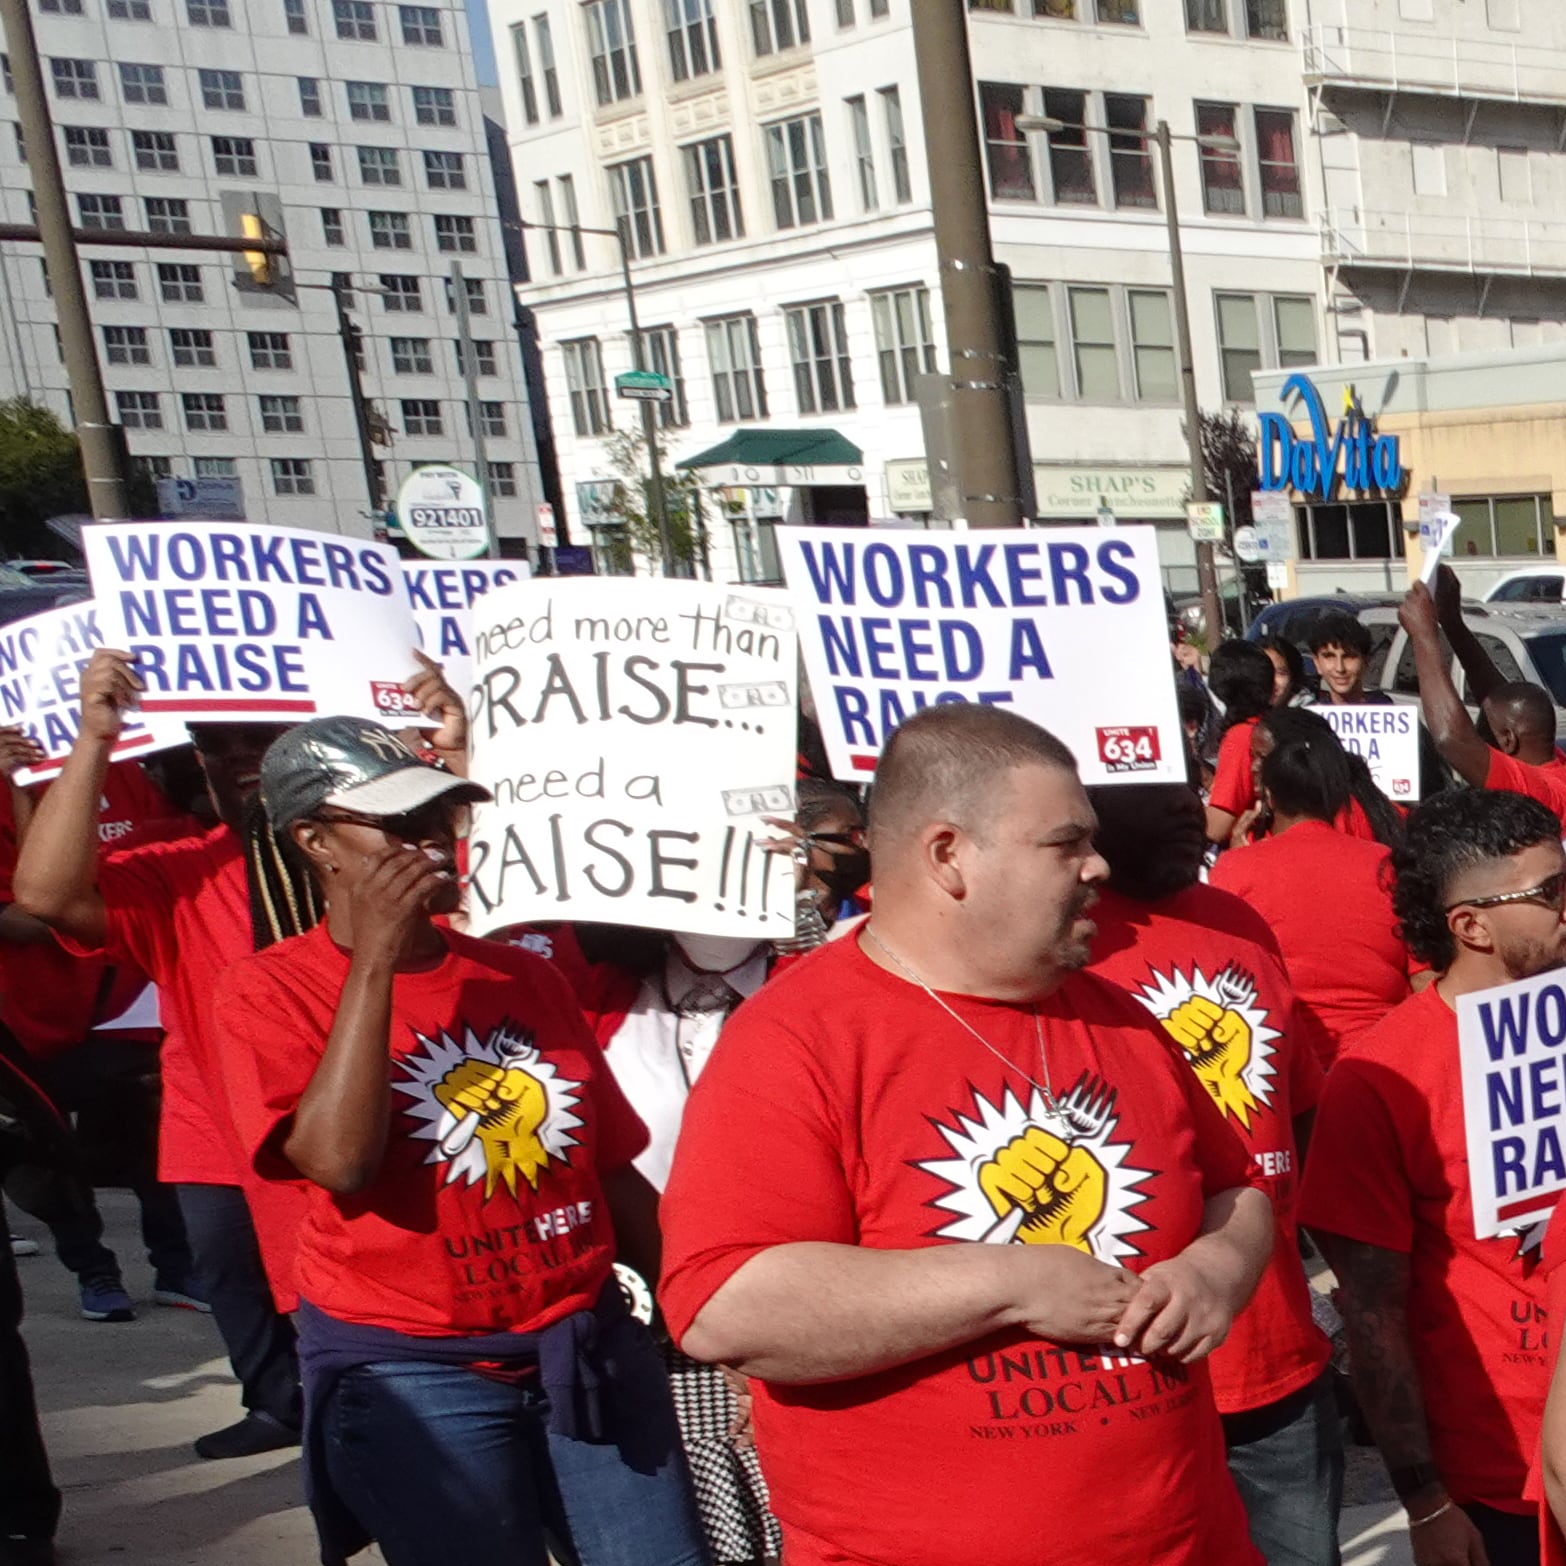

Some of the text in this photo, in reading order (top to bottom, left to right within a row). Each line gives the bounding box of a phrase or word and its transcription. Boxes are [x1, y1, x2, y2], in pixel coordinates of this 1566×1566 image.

[1258, 373, 1399, 503] DaVita
[1070, 475, 1157, 493] SHAP'S
[413, 509, 483, 528] 921401
[106, 532, 394, 597] WORKERS
[799, 539, 1141, 609] WORKERS
[119, 588, 335, 641] NEED A
[475, 598, 780, 665] need more than
[129, 643, 310, 693] RAISE
[817, 613, 1054, 682] NEED A
[1321, 711, 1410, 734] ORKERS
[1104, 736, 1153, 763] 634
[493, 756, 663, 807] need a
[985, 1372, 1142, 1421] LOCAL
[969, 1425, 1014, 1440] NEW
[1021, 1420, 1078, 1439] YORK
